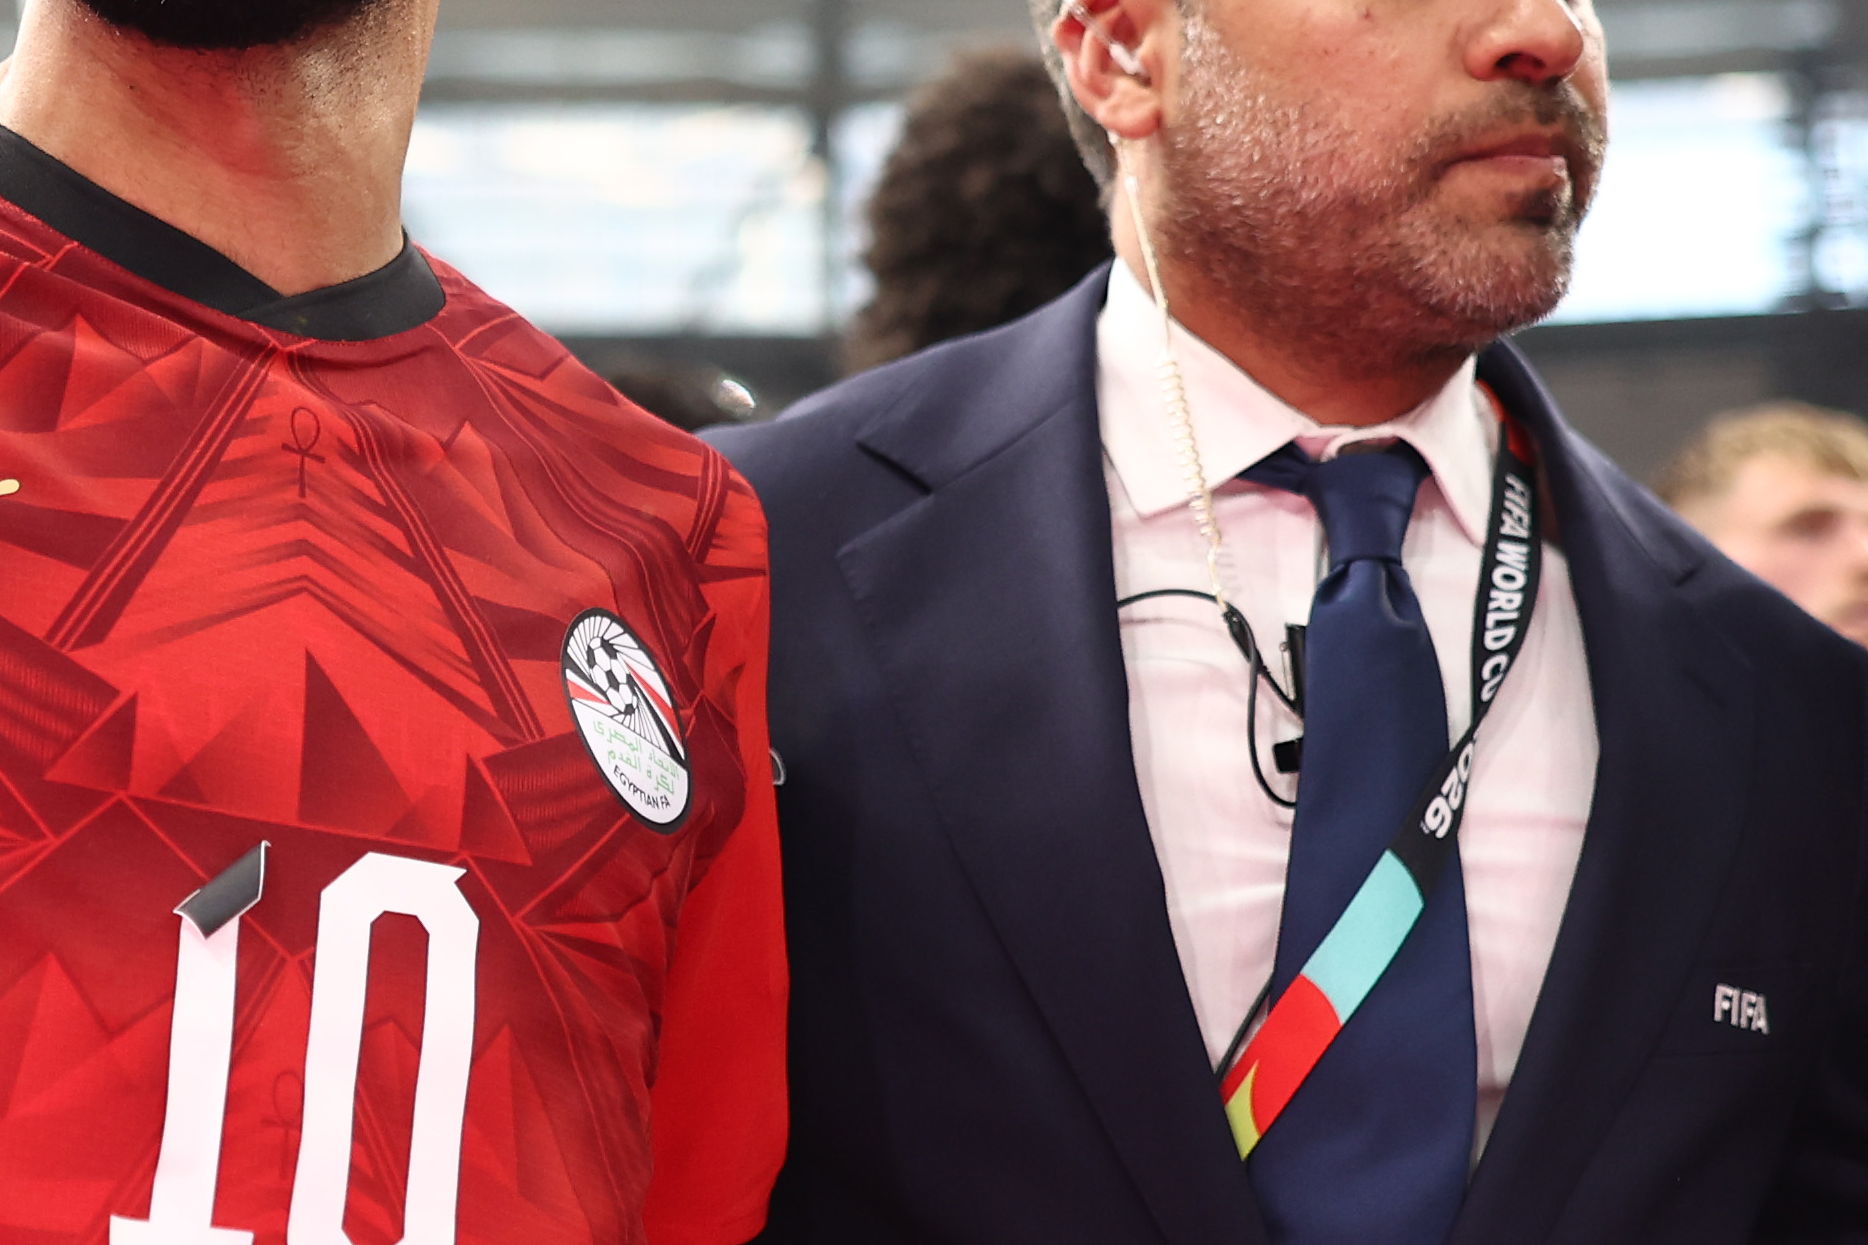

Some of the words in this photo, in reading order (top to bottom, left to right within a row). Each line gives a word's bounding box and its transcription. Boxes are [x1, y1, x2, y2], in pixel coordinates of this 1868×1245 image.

[1498, 472, 1532, 539] FIFA
[1483, 541, 1531, 651] WORLD
[1480, 653, 1510, 703] CU
[613, 764, 660, 810] EGYPTIAN
[660, 794, 671, 810] FA
[1424, 738, 1475, 839] 026
[109, 840, 480, 1245] 10
[1713, 983, 1770, 1035] FIFA
